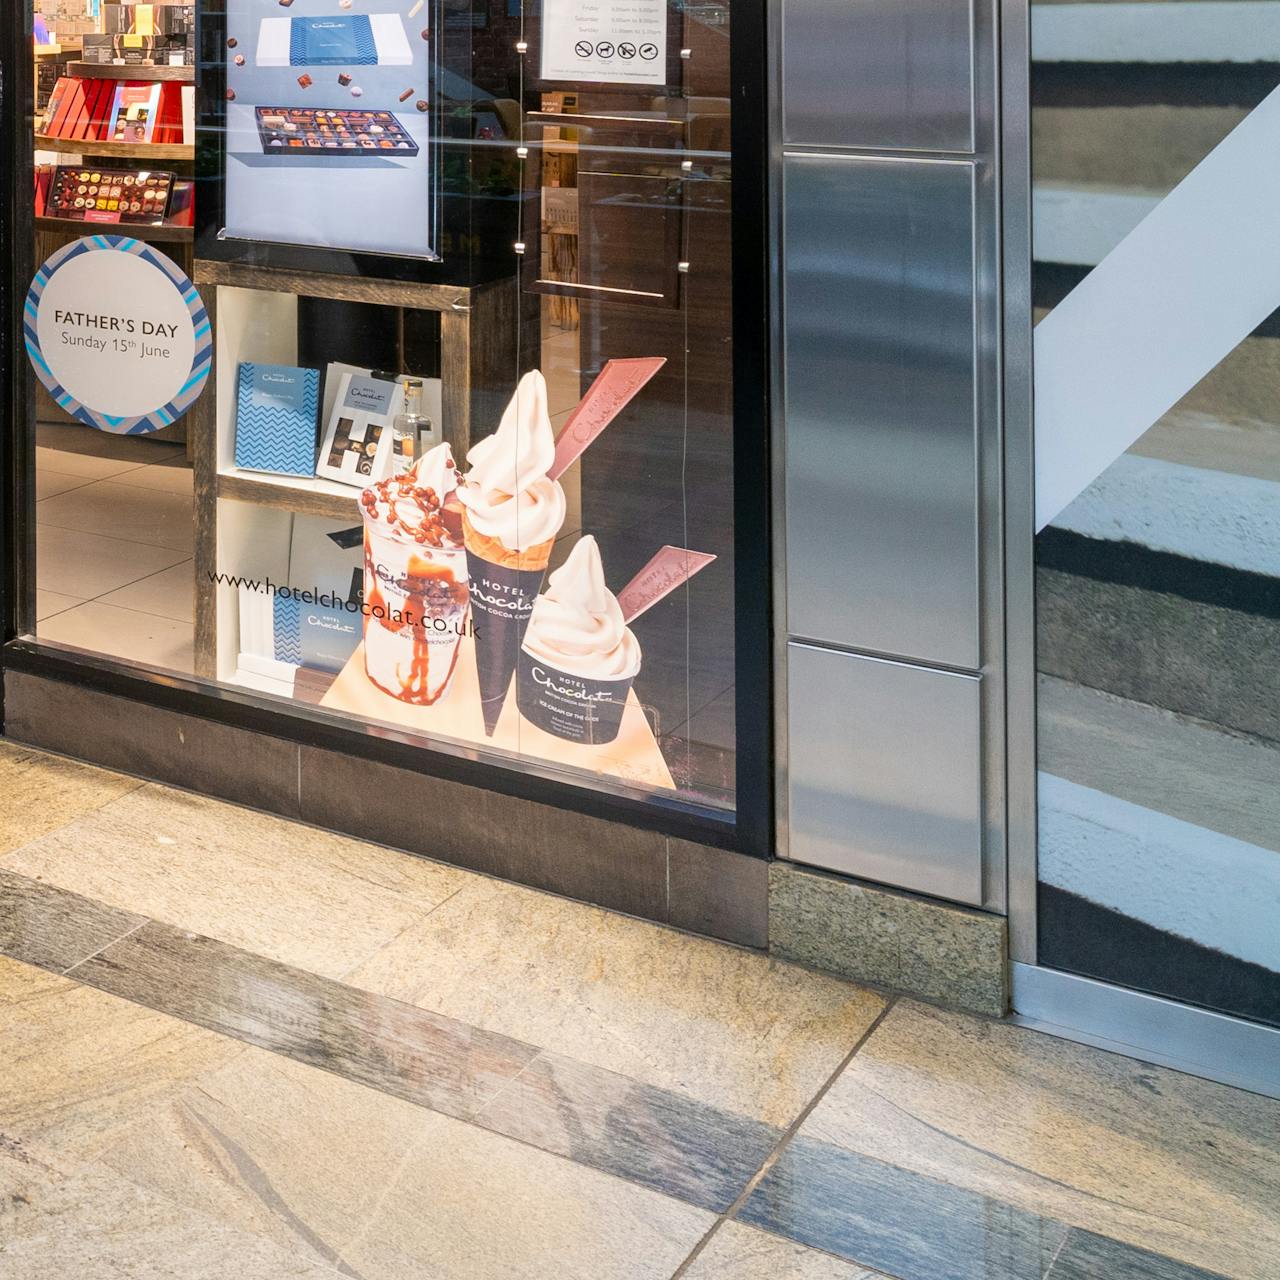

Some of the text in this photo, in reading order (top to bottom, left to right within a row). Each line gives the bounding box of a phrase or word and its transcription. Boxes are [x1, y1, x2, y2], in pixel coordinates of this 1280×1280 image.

[142, 321, 178, 338] DAY
[61, 331, 170, 358] Sunday 15th June
[482, 578, 525, 596] HOTEL
[208, 570, 481, 640] www.hotelchocolat.co.uk
[488, 608, 513, 619] COCOA
[559, 676, 586, 688] HOTEL
